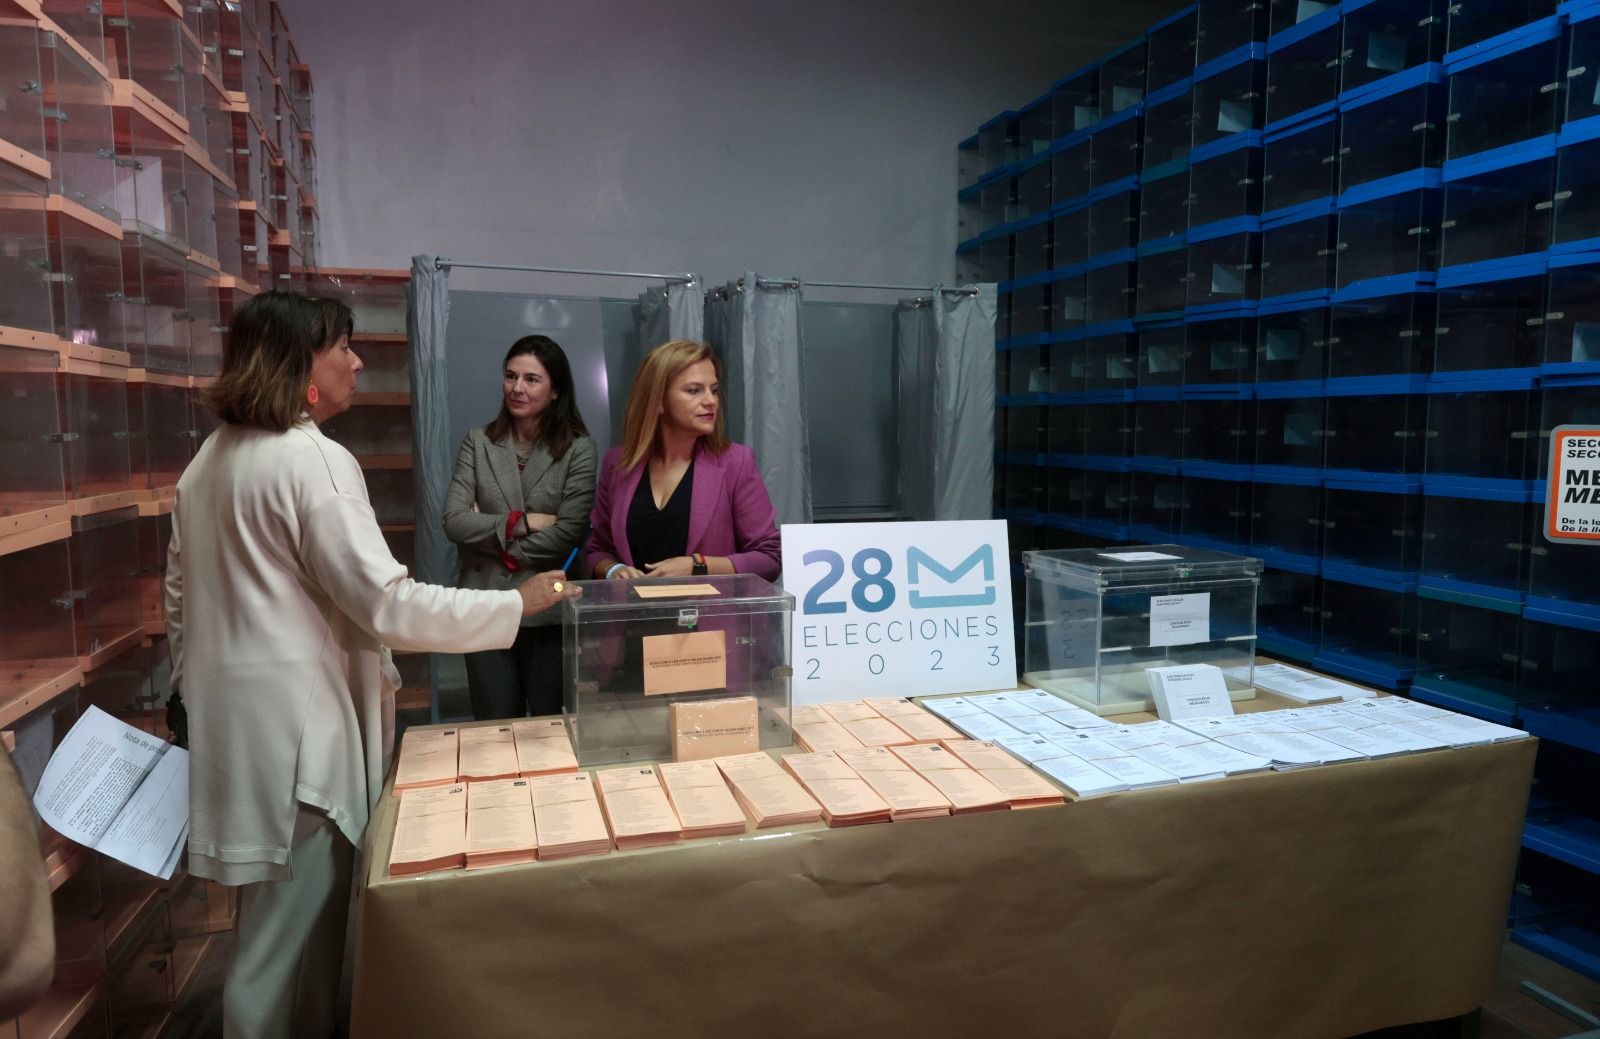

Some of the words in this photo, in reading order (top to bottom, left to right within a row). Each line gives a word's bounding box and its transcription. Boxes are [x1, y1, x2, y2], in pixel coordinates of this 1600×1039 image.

[1567, 439, 1600, 448] SEC
[1567, 449, 1600, 458] SEC
[1561, 517, 1576, 525] De
[803, 615, 998, 648] ELECCIONES
[123, 732, 140, 745] Nota
